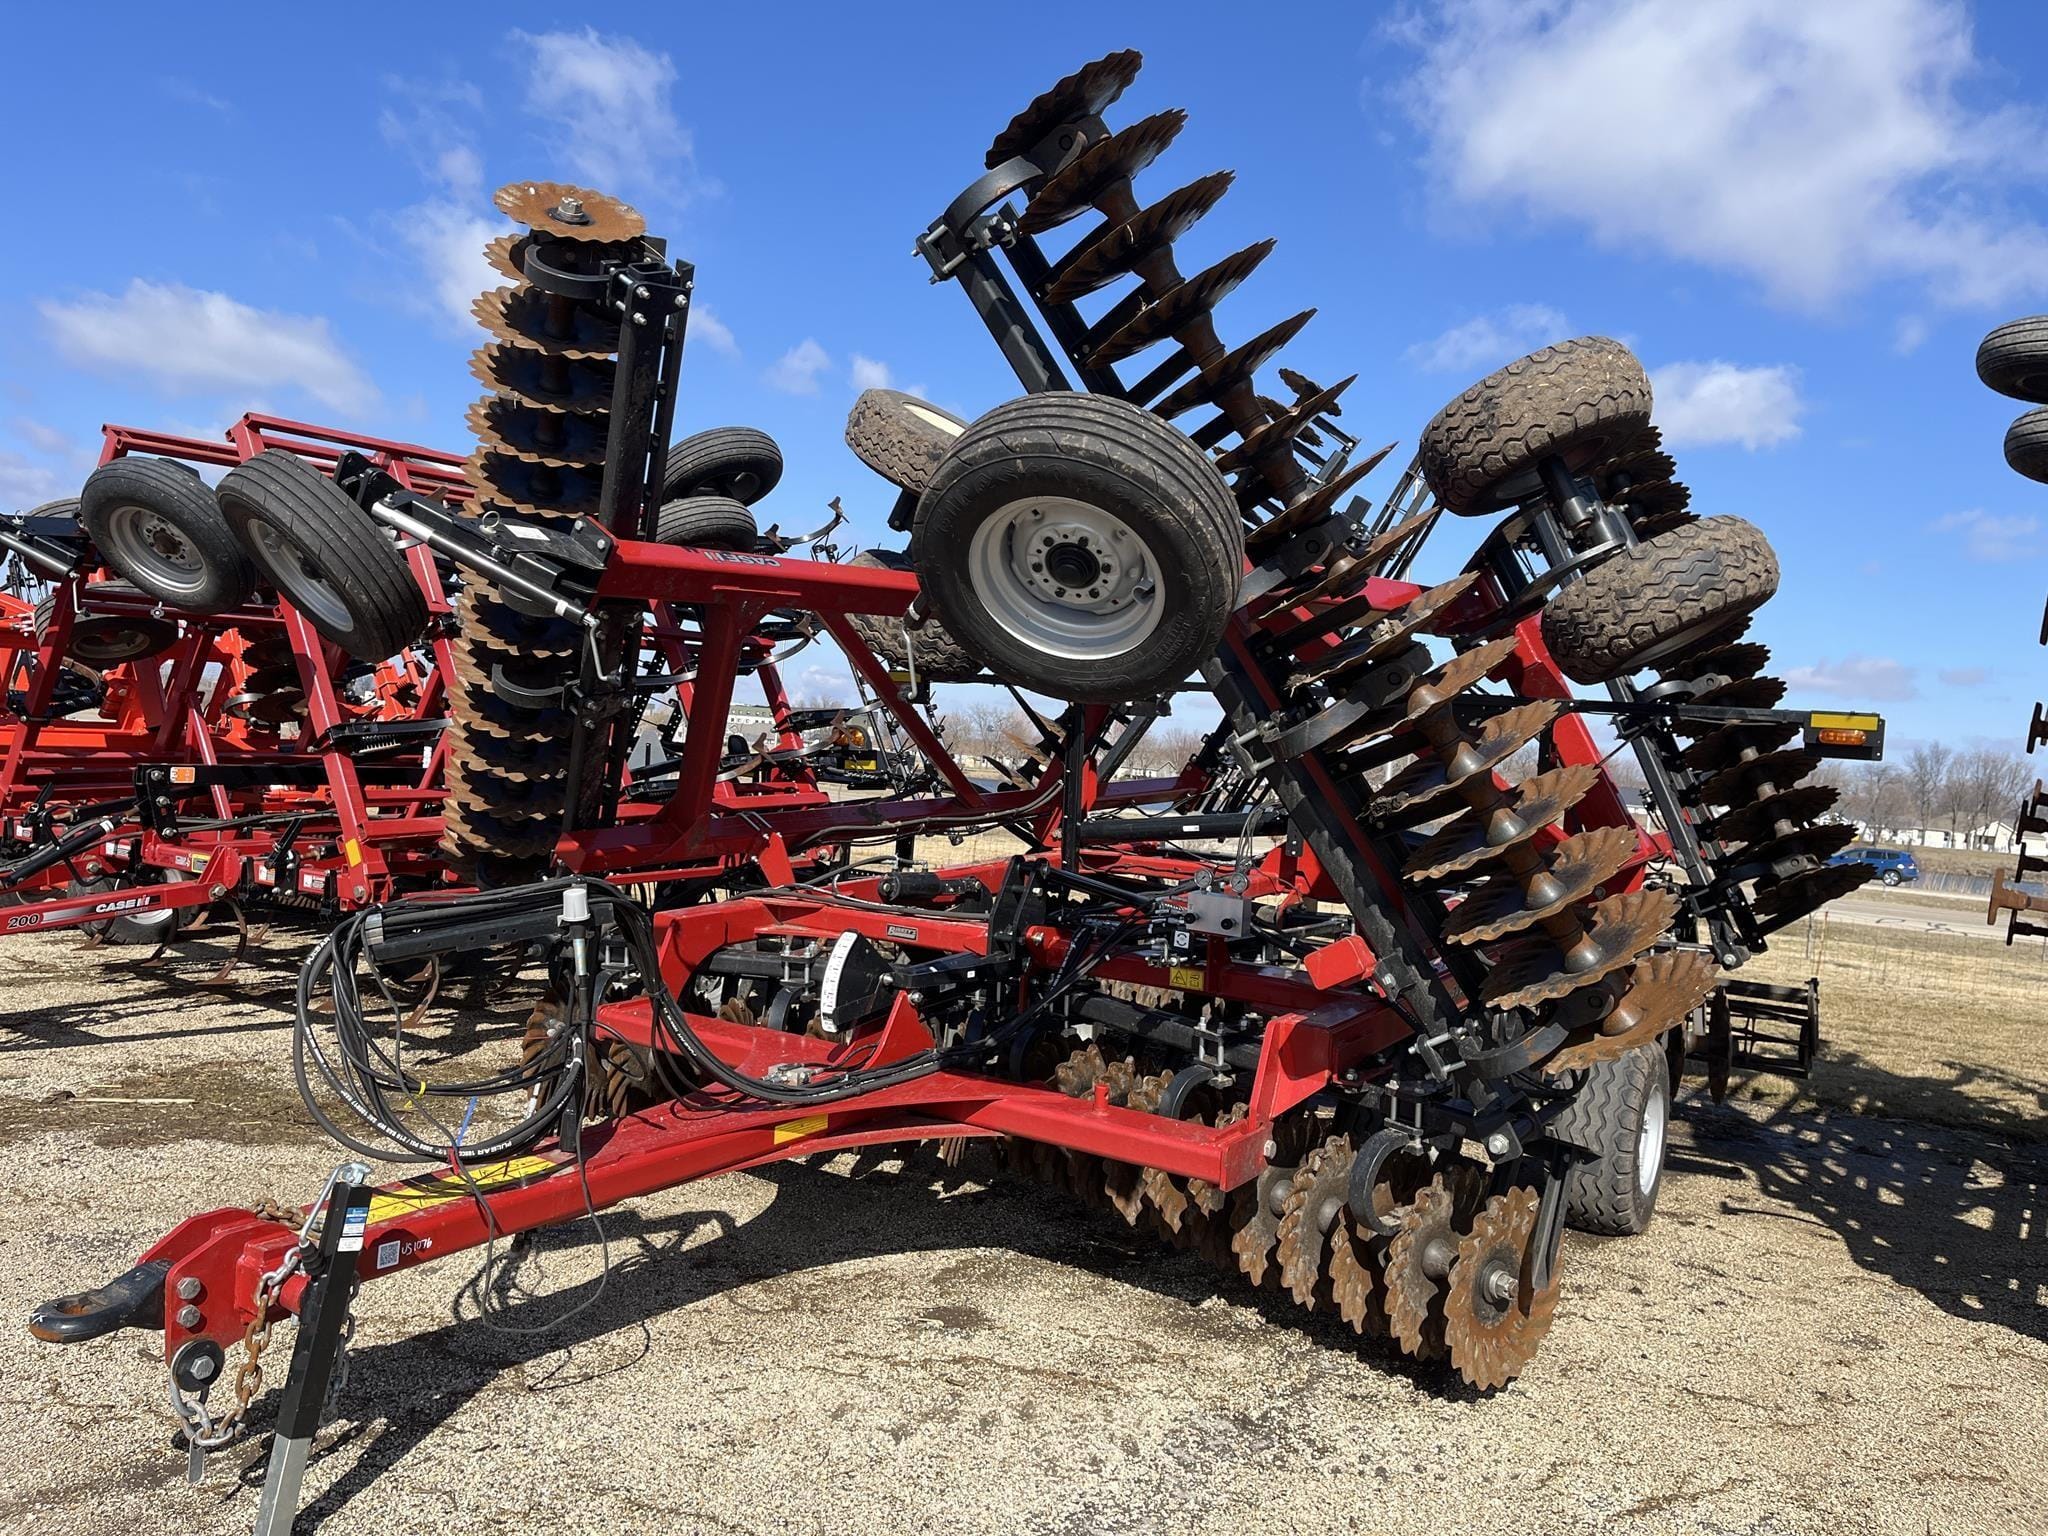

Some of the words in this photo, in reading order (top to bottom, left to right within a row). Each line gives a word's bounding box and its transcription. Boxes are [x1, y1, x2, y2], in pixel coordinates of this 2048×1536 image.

[722, 552, 780, 567] CASE
[96, 898, 138, 913] CASE
[7, 914, 39, 929] 200
